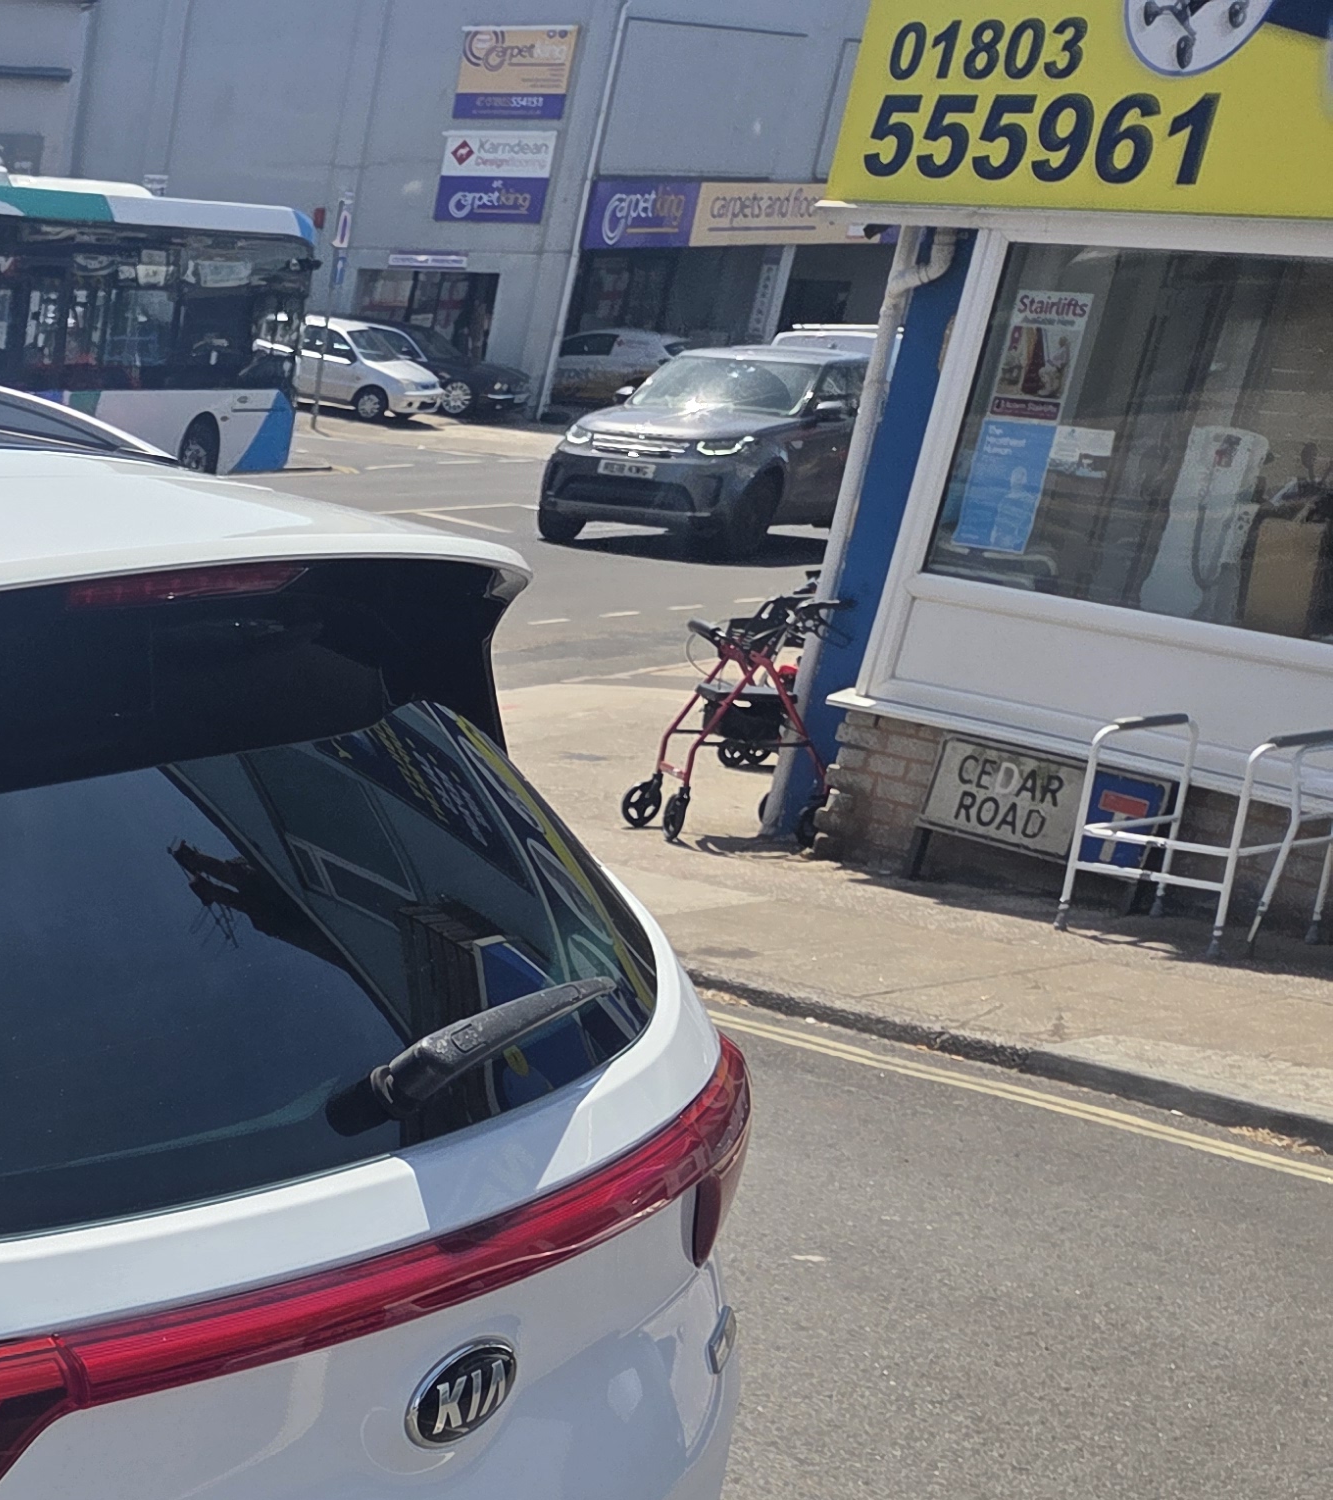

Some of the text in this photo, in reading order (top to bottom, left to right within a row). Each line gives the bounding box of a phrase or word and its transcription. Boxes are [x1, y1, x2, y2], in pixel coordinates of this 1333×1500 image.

[889, 16, 1088, 80] 01803
[477, 138, 549, 155] Karndean
[863, 92, 1222, 185] 555961
[710, 192, 763, 223] carpets
[1017, 294, 1089, 318] Stairlifts
[958, 754, 1065, 808] CEDAR
[954, 791, 1046, 839] ROAD
[433, 1359, 507, 1435] KIA
